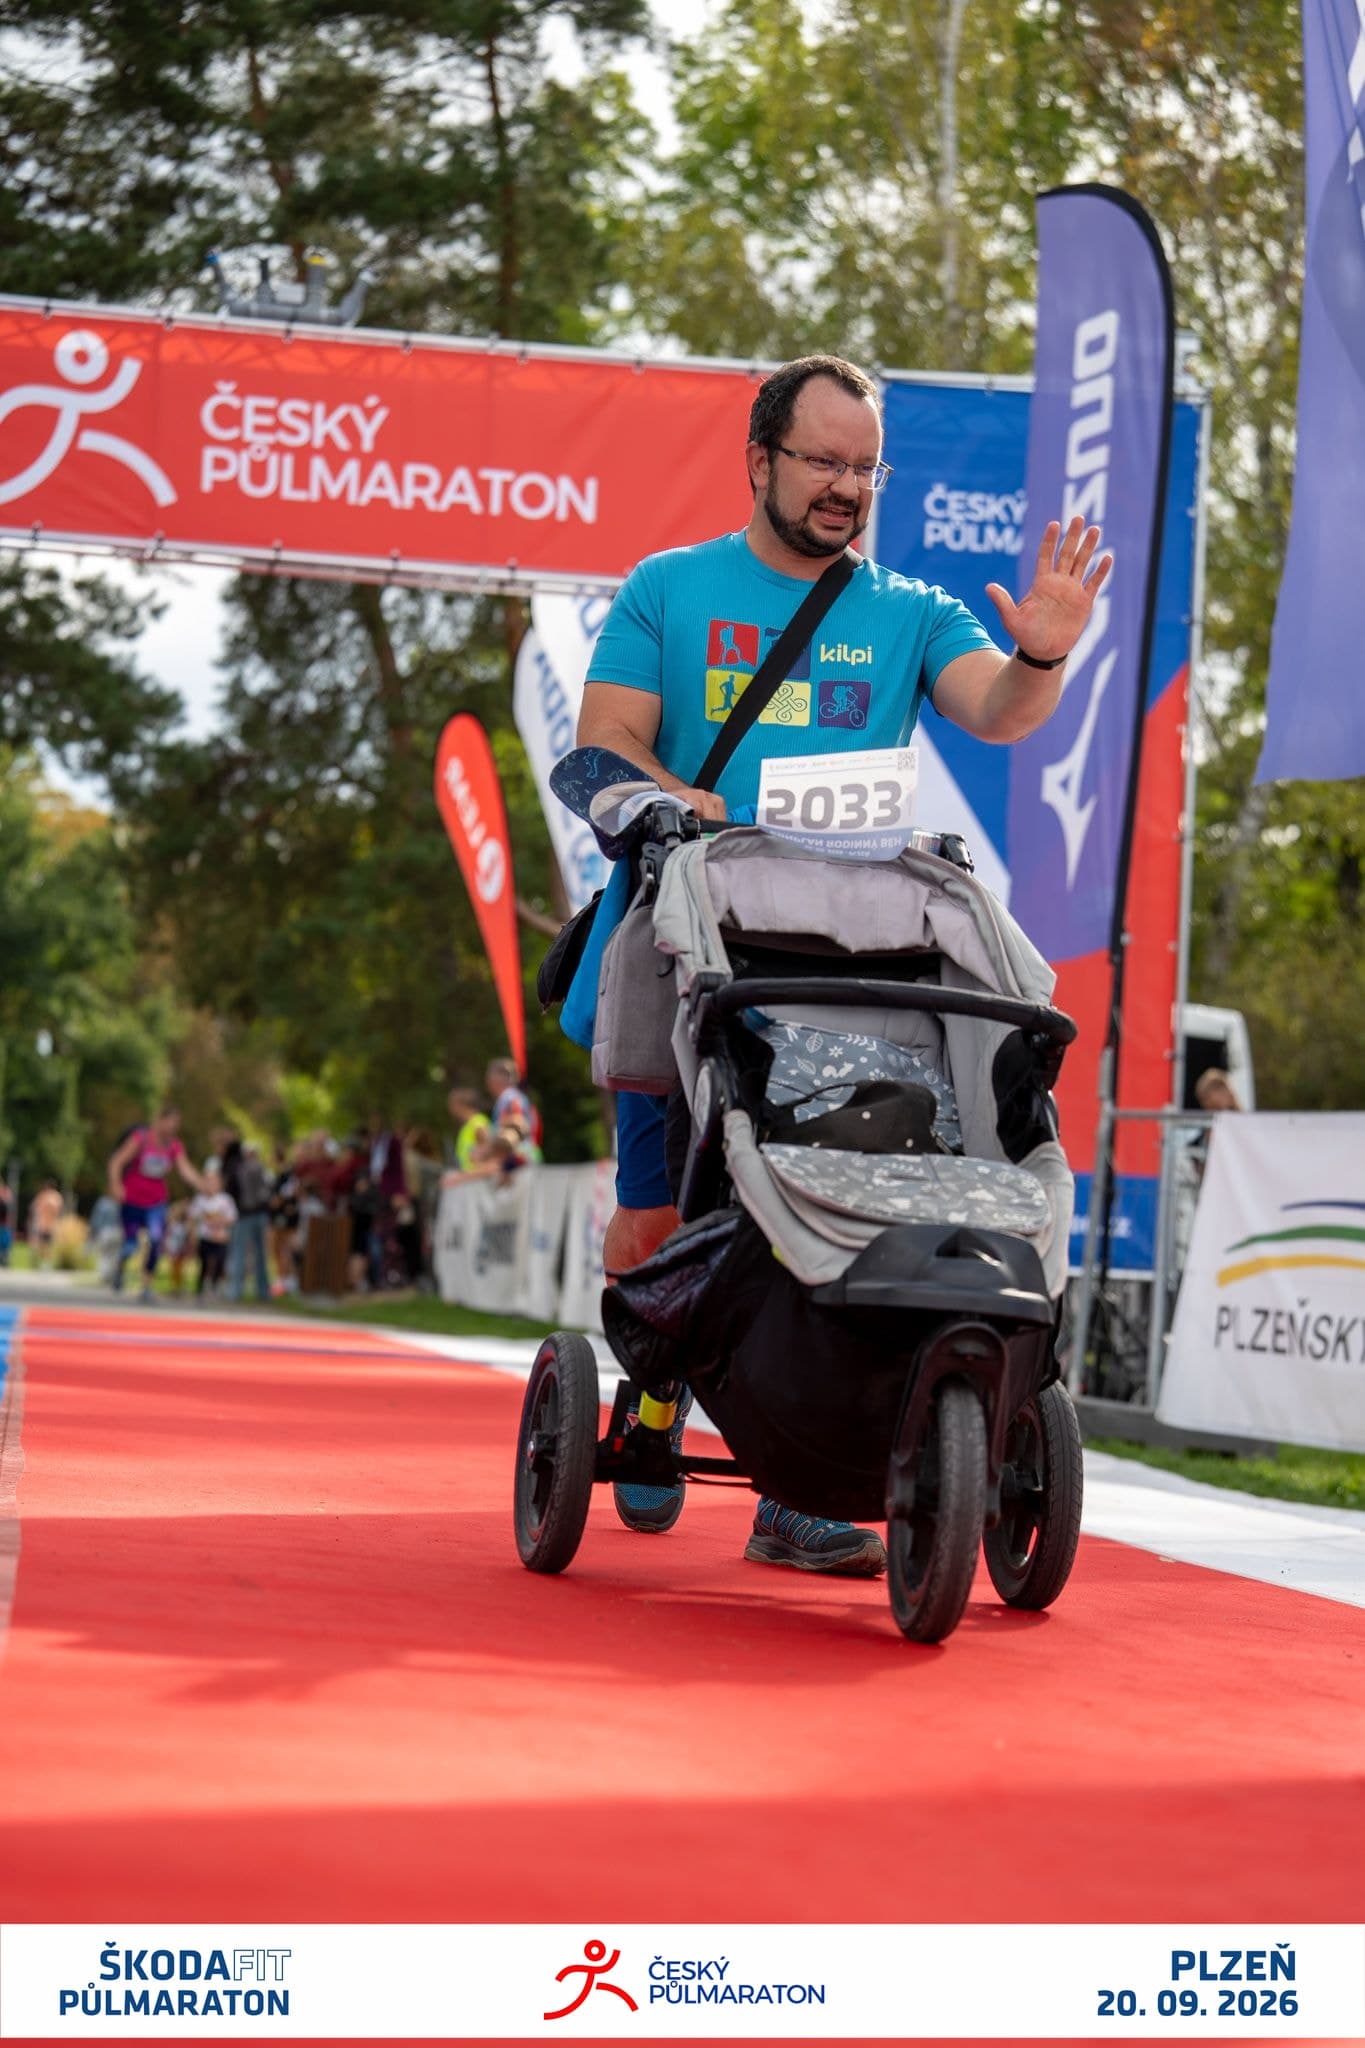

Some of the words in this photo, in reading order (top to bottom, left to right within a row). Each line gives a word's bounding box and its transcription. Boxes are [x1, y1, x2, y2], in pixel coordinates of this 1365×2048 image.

[201, 380, 389, 453] ČESKÝ
[201, 443, 598, 525] PŮLMARATON
[923, 481, 1028, 525] ČESKÝ
[819, 643, 873, 666] kilpi
[765, 780, 902, 831] 2033
